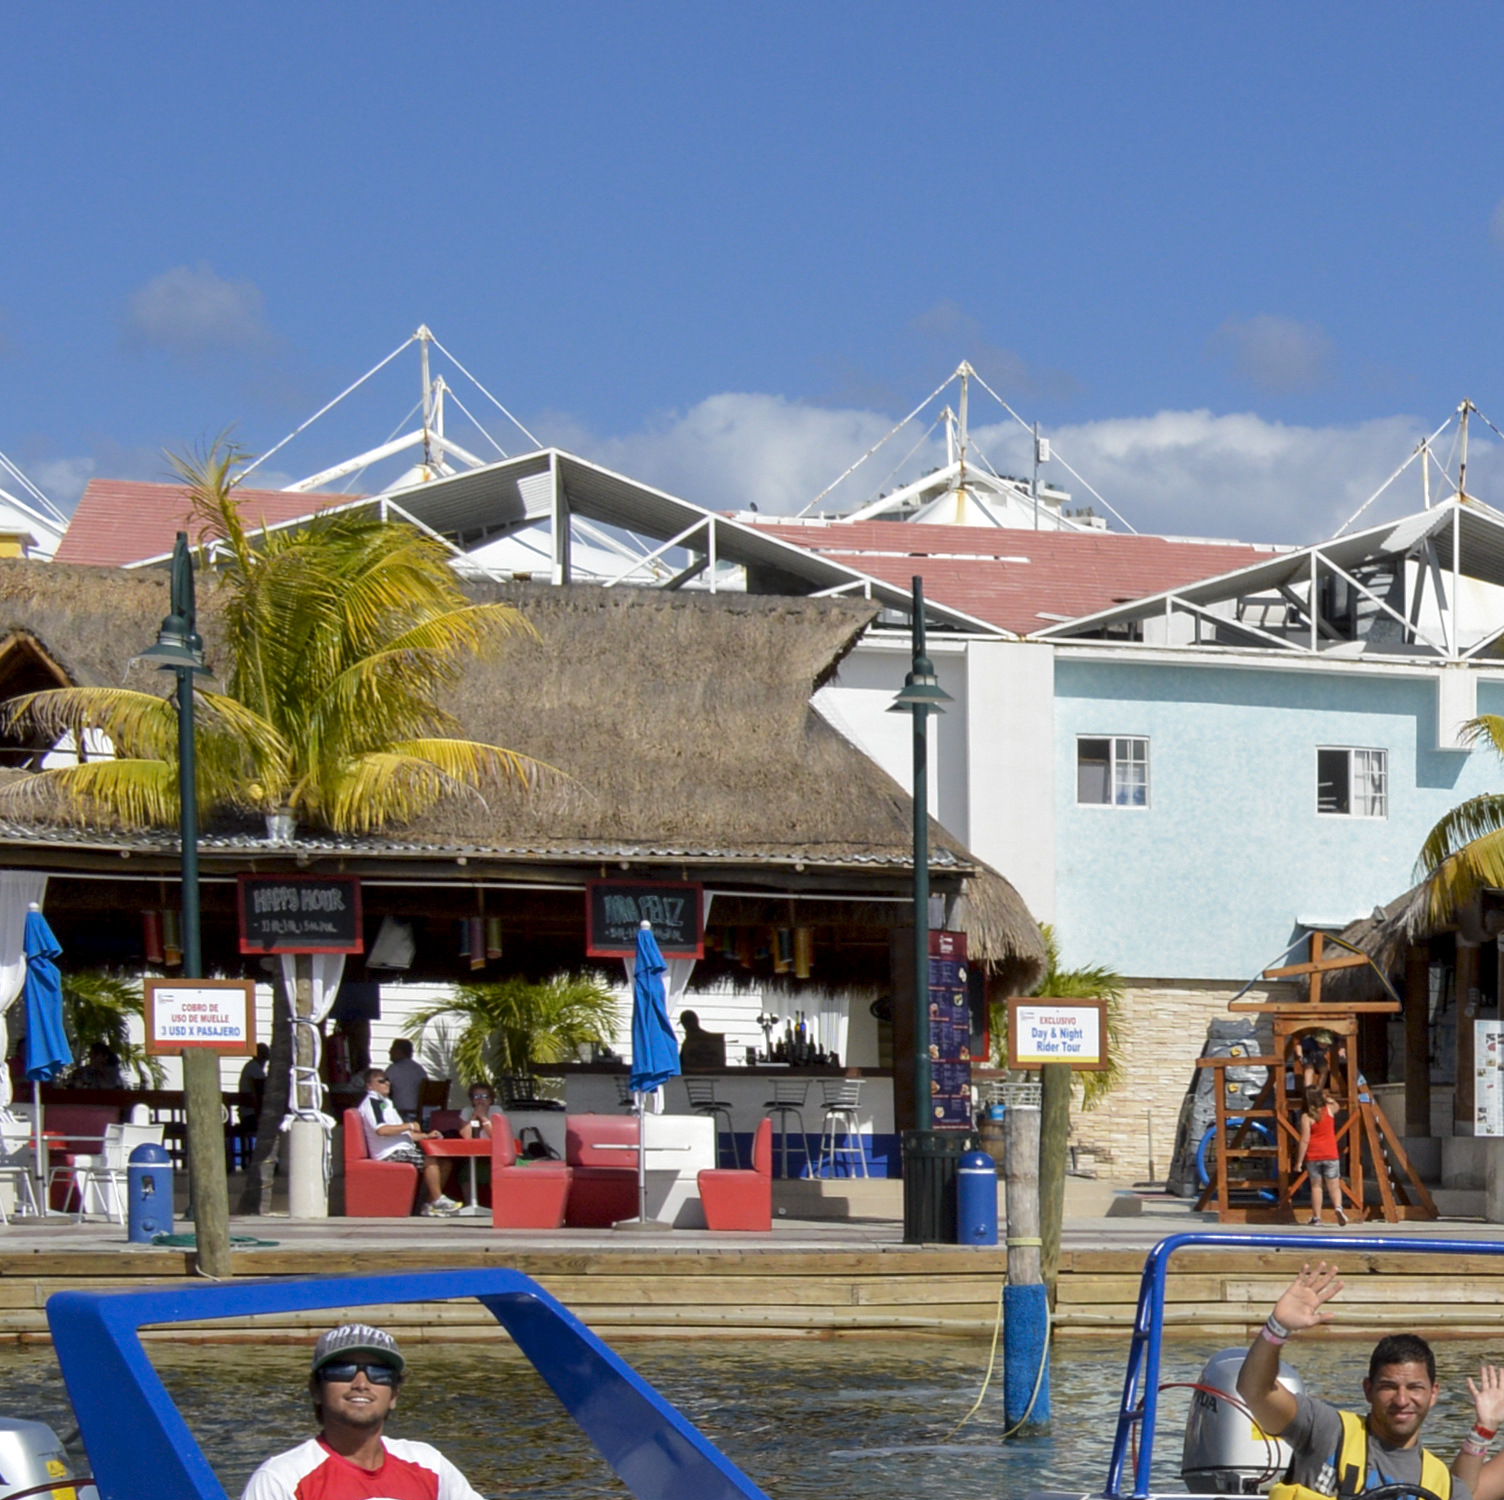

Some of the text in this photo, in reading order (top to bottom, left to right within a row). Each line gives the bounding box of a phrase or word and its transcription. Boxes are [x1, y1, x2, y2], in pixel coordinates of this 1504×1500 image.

[301, 887, 346, 912] HOUR
[181, 1003, 219, 1012] COBRO DE
[171, 1014, 229, 1023] USO DE MUELLE
[1039, 1016, 1077, 1025] EXCLUSIVO
[161, 1026, 241, 1036] 3 USD X PASAJERO
[1031, 1027, 1083, 1041] Day & Night
[1037, 1041, 1081, 1052] Rider Tour
